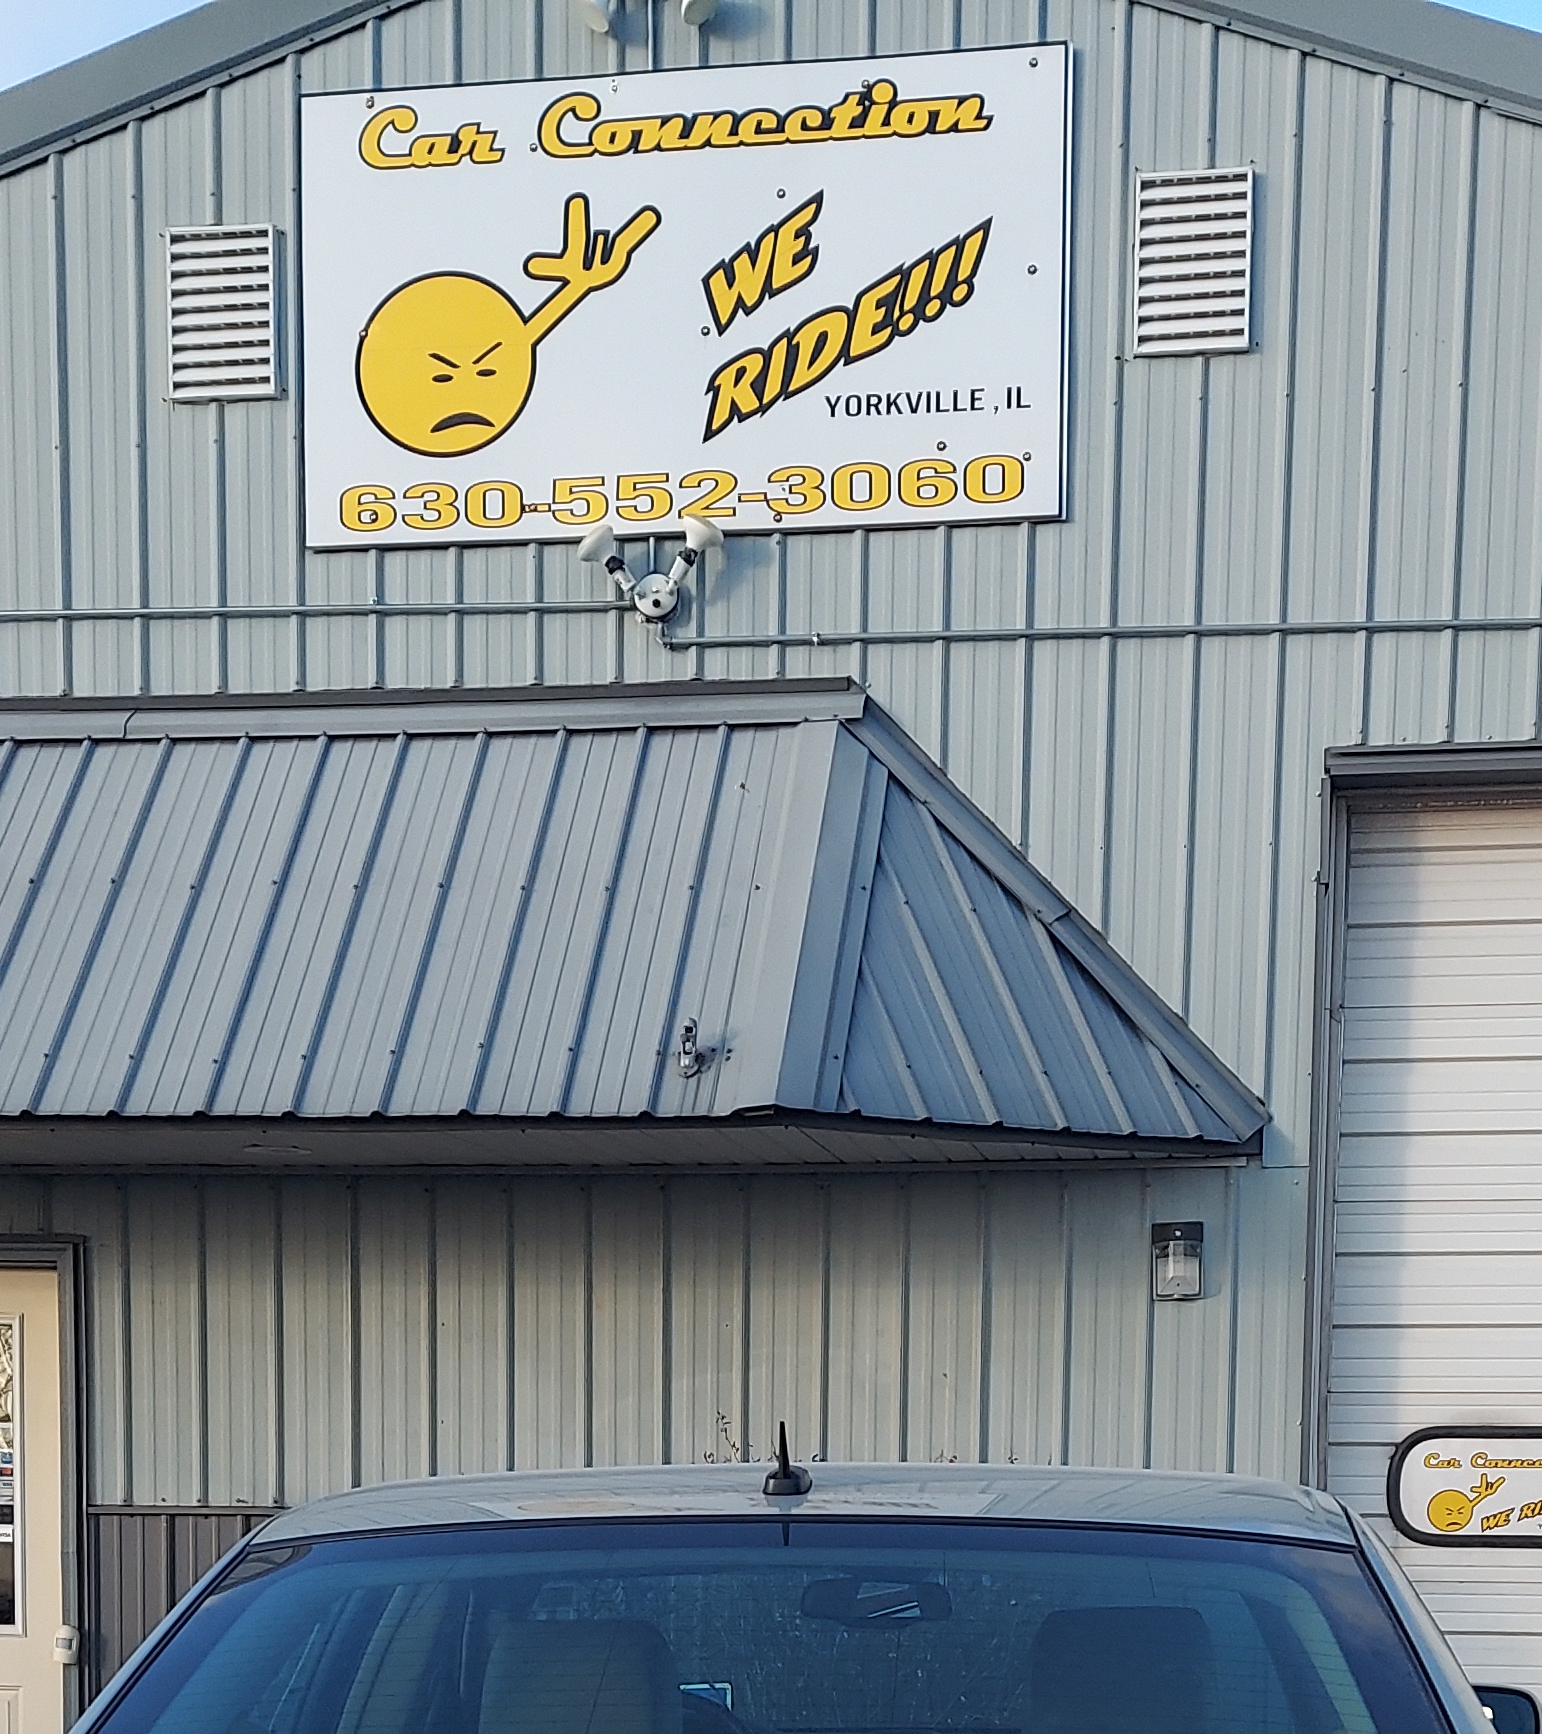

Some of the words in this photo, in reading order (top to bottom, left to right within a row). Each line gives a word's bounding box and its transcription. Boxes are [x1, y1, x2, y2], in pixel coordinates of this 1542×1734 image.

[360, 105, 506, 169] Car
[538, 79, 994, 158] Connection
[702, 189, 825, 336] WE
[702, 216, 994, 443] RIDE!!!
[340, 454, 1028, 532] 630-552-3060
[1424, 1452, 1462, 1469] Car
[1480, 1506, 1516, 1533] WE
